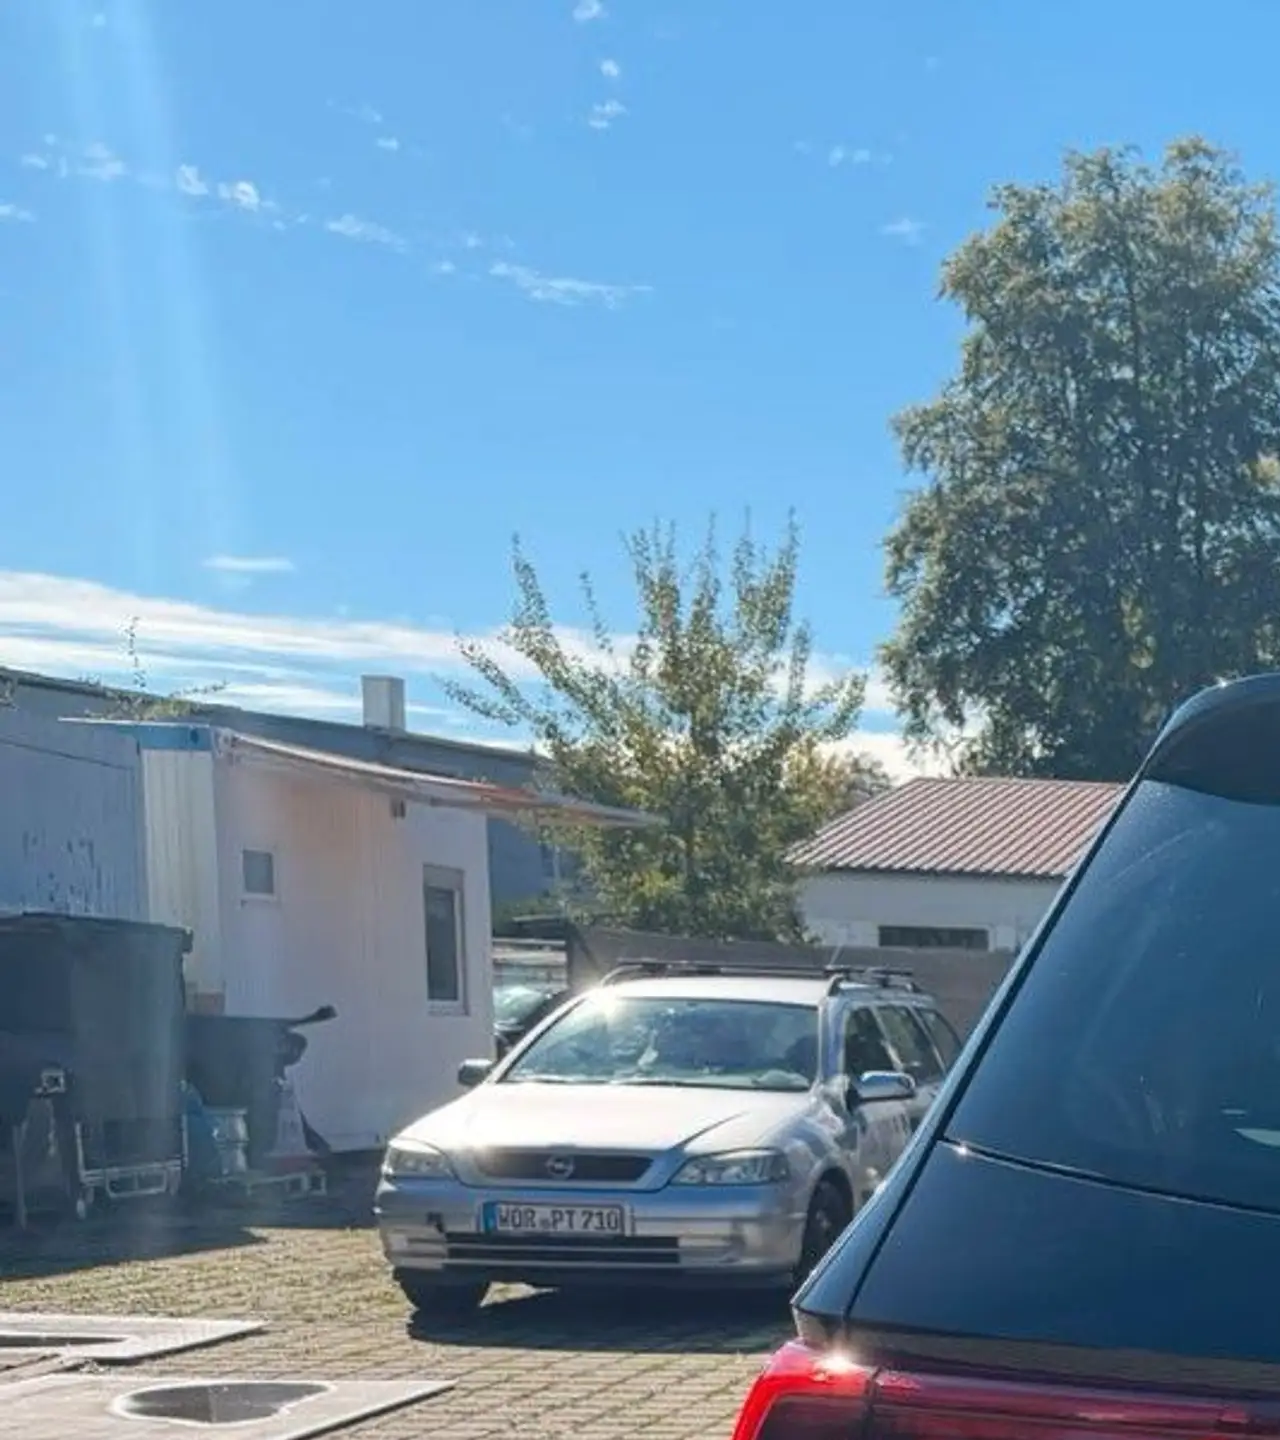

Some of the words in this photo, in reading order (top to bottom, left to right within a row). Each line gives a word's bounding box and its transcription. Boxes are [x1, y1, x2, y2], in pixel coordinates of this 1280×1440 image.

[500, 1207, 536, 1228] WOR
[552, 1209, 576, 1229] PT
[581, 1210, 618, 1230] 710
